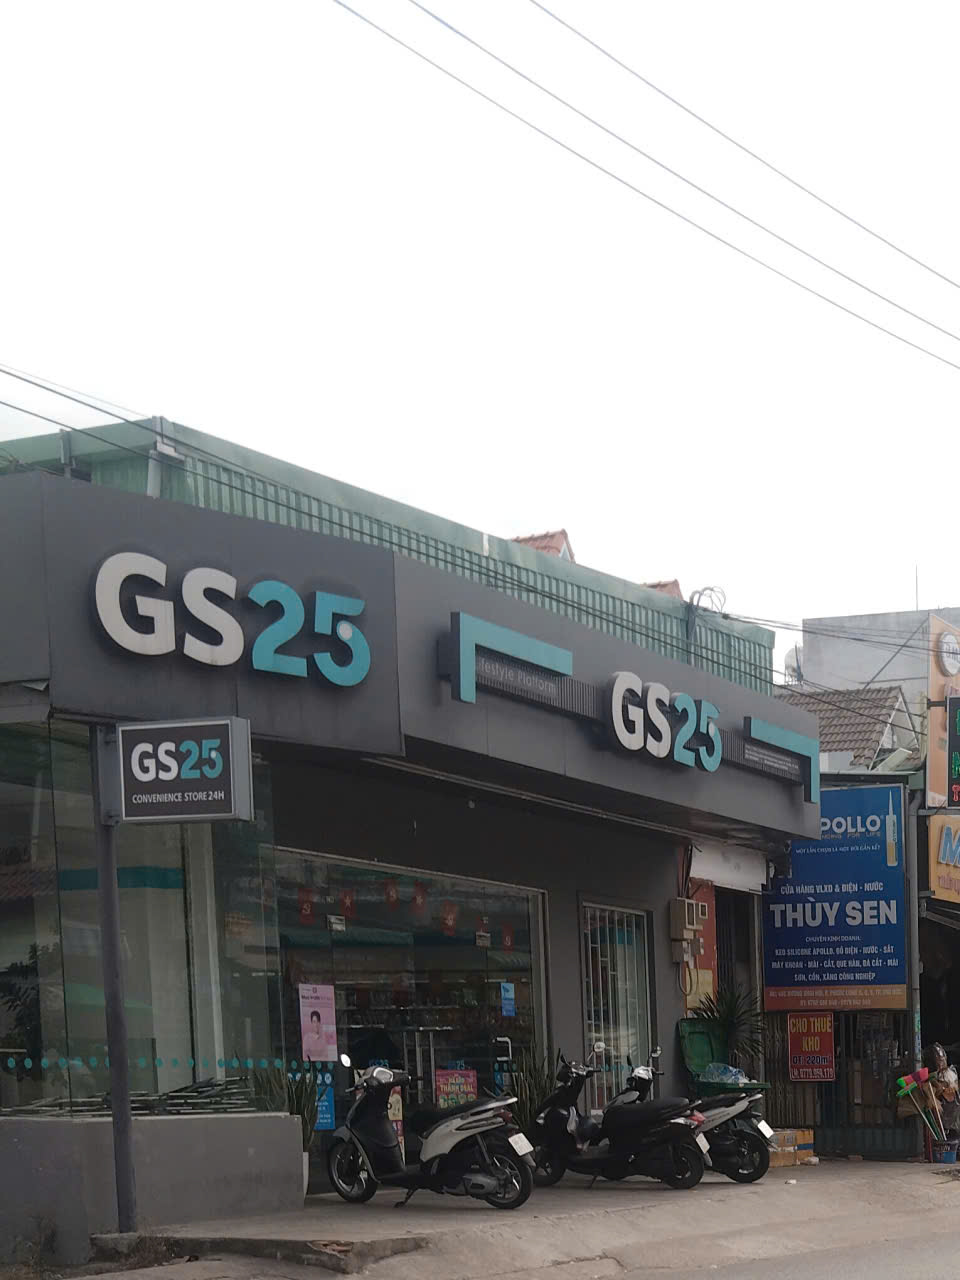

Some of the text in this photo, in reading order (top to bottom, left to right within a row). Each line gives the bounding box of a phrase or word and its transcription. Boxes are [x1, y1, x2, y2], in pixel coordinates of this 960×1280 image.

[95, 552, 371, 687] GS25
[611, 671, 723, 773] GS25
[131, 739, 224, 782] GS25
[132, 790, 225, 804] CONVENIENCE STORE 24H
[780, 883, 795, 895] CỬA
[795, 882, 815, 894] HÀNG
[834, 884, 841, 893] &
[841, 881, 858, 894] ĐIỆN
[864, 880, 884, 892] NƯỚC
[769, 897, 897, 928] THÙY SEN
[836, 959, 848, 968] QUE
[790, 1015, 832, 1033] CHO THUÊ
[802, 1036, 821, 1052] KHO
